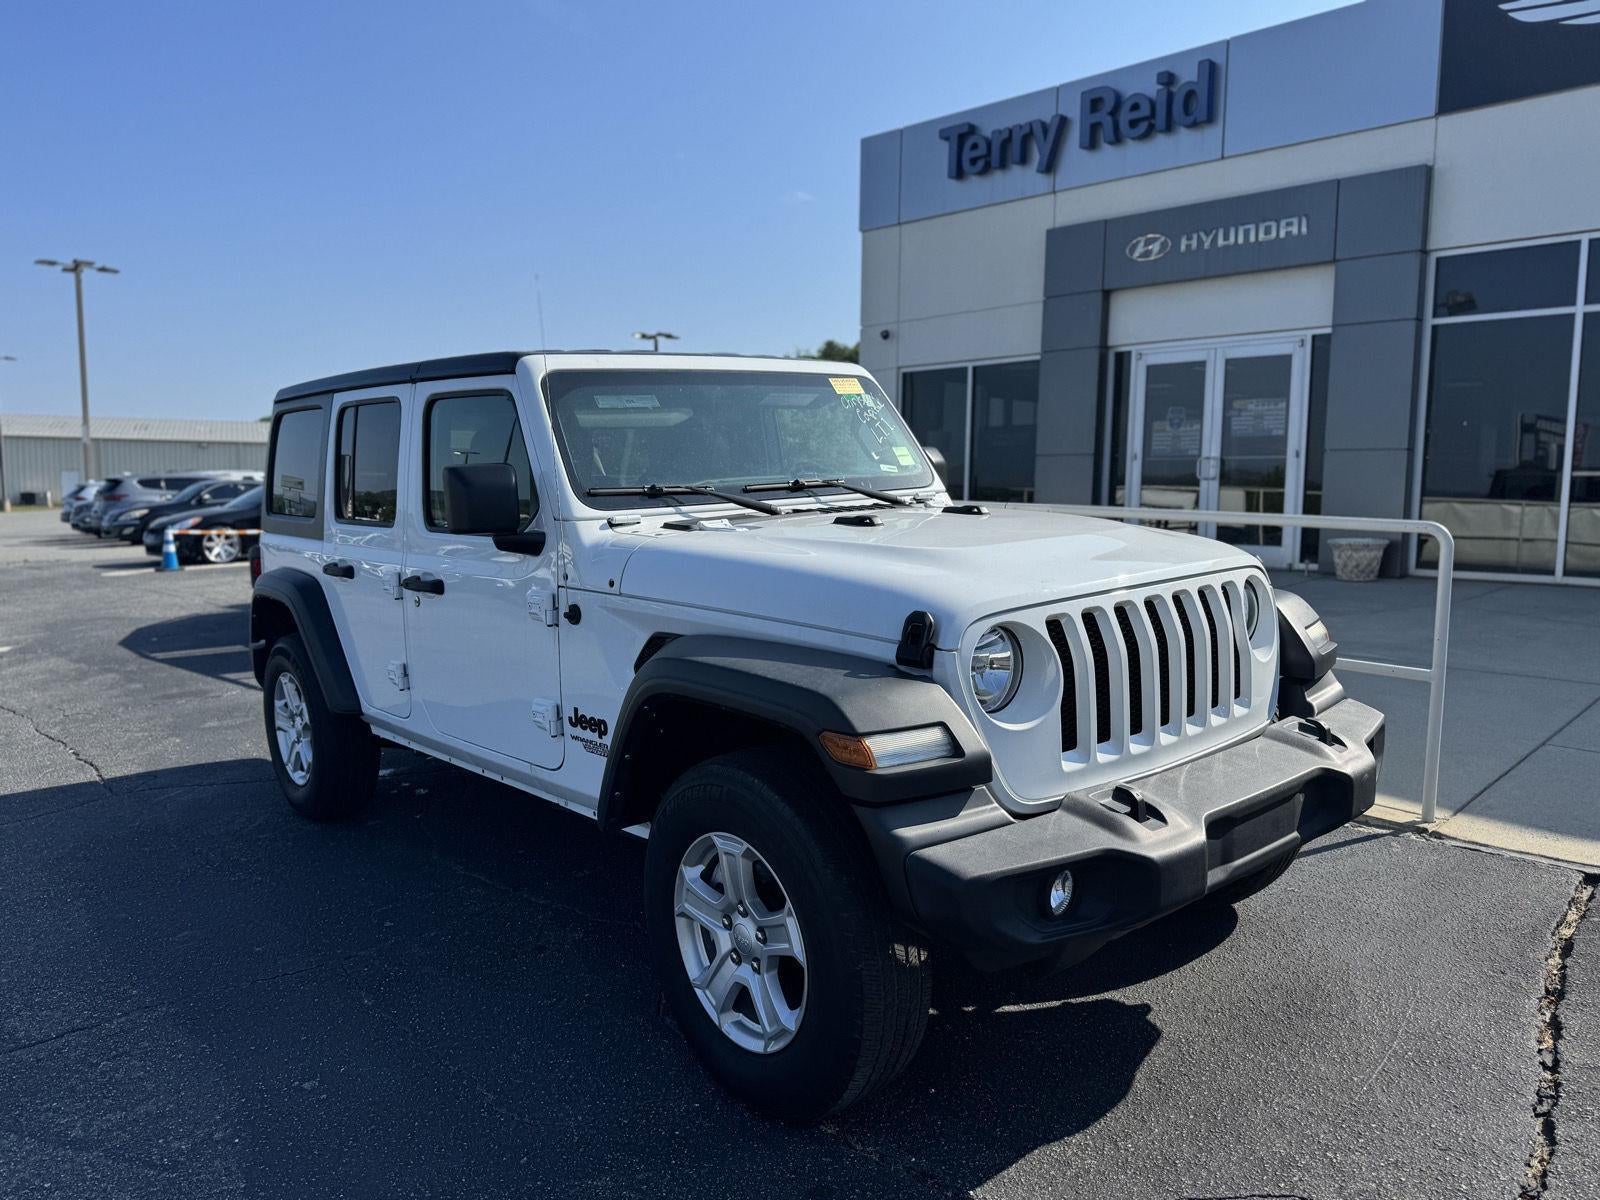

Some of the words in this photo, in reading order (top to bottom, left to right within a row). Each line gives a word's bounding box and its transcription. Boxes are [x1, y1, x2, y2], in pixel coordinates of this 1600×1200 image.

[939, 113, 1068, 179] Terry
[1079, 58, 1216, 150] Reid
[1180, 216, 1307, 252] HYUNDAI
[568, 706, 608, 740] Jeep
